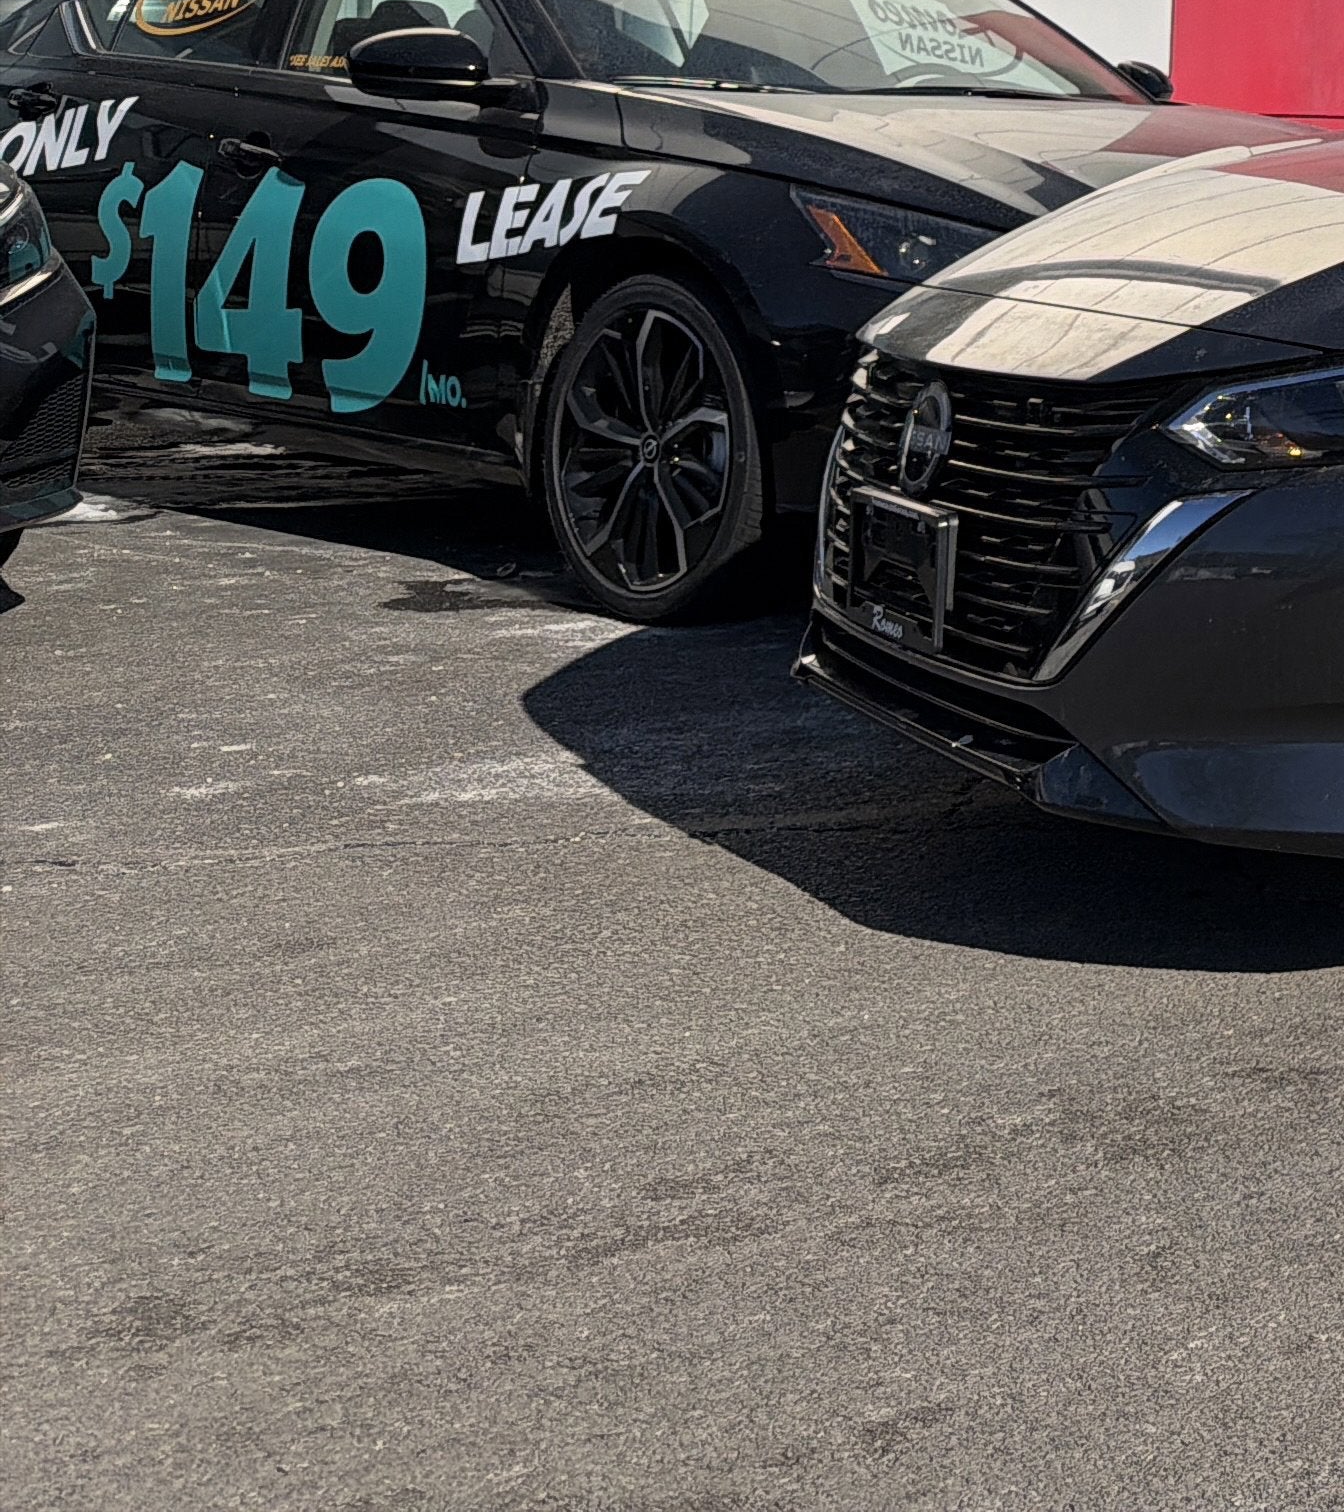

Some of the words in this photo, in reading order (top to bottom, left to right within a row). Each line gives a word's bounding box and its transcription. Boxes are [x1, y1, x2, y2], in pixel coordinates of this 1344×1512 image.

[0, 96, 140, 176] ONLY
[455, 170, 652, 264] LEASE
[91, 159, 427, 413] $149
[420, 360, 468, 408] /MO.
